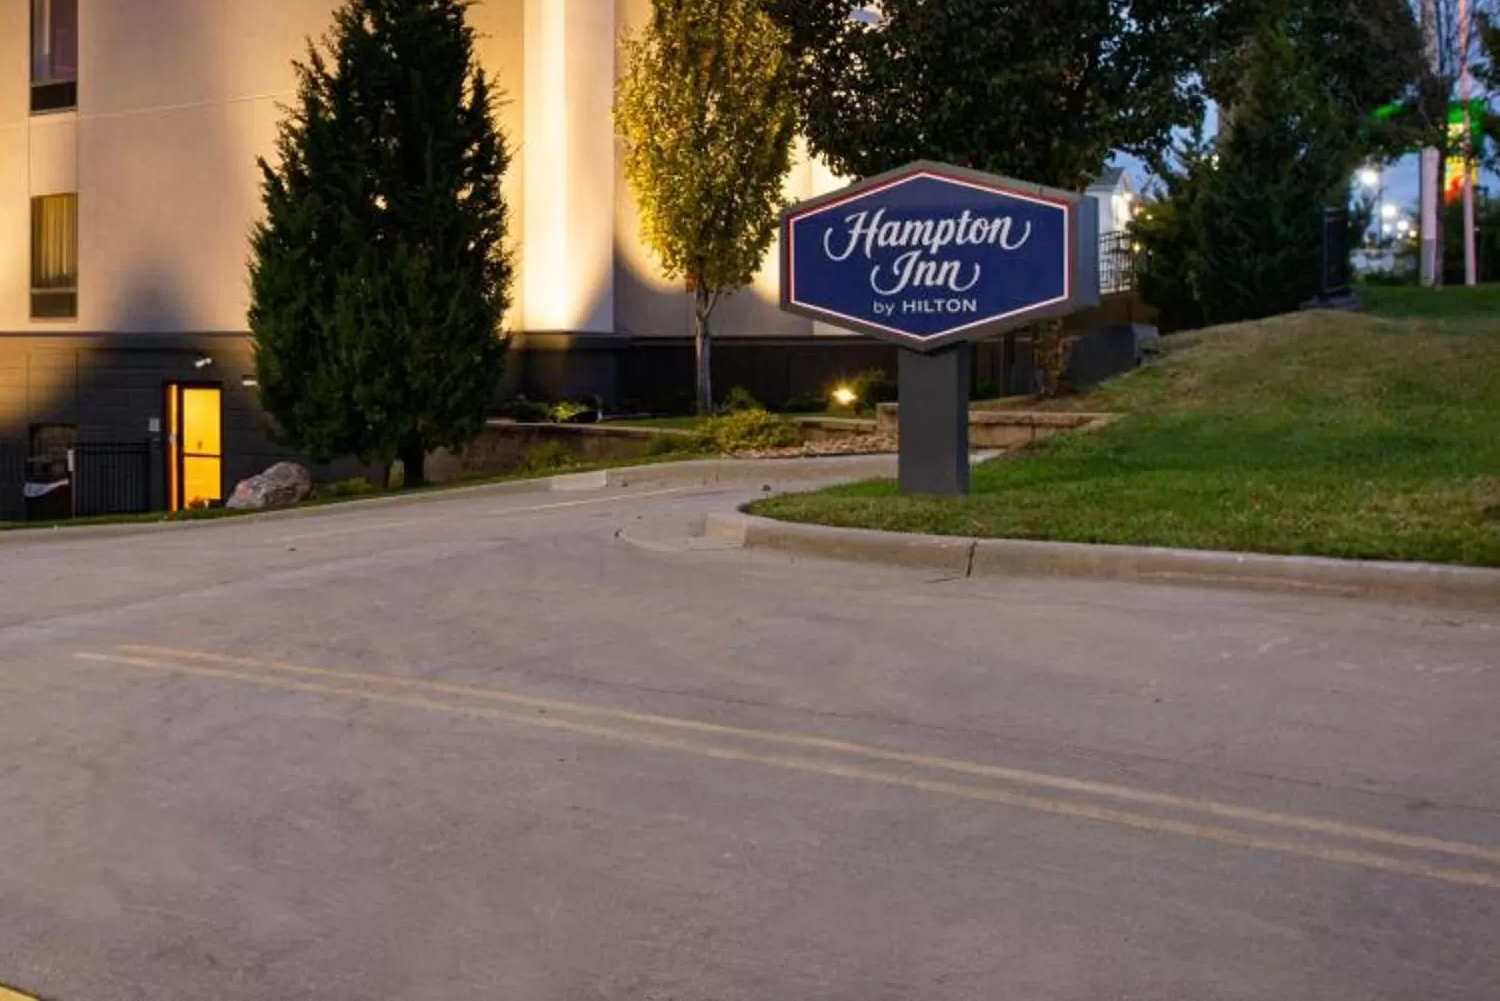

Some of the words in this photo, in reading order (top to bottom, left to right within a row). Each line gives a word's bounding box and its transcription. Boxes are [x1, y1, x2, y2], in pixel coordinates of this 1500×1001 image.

[823, 207, 1032, 262] Hampton
[870, 249, 981, 296] Inn
[872, 299, 895, 317] by
[902, 299, 977, 313] HILTON
